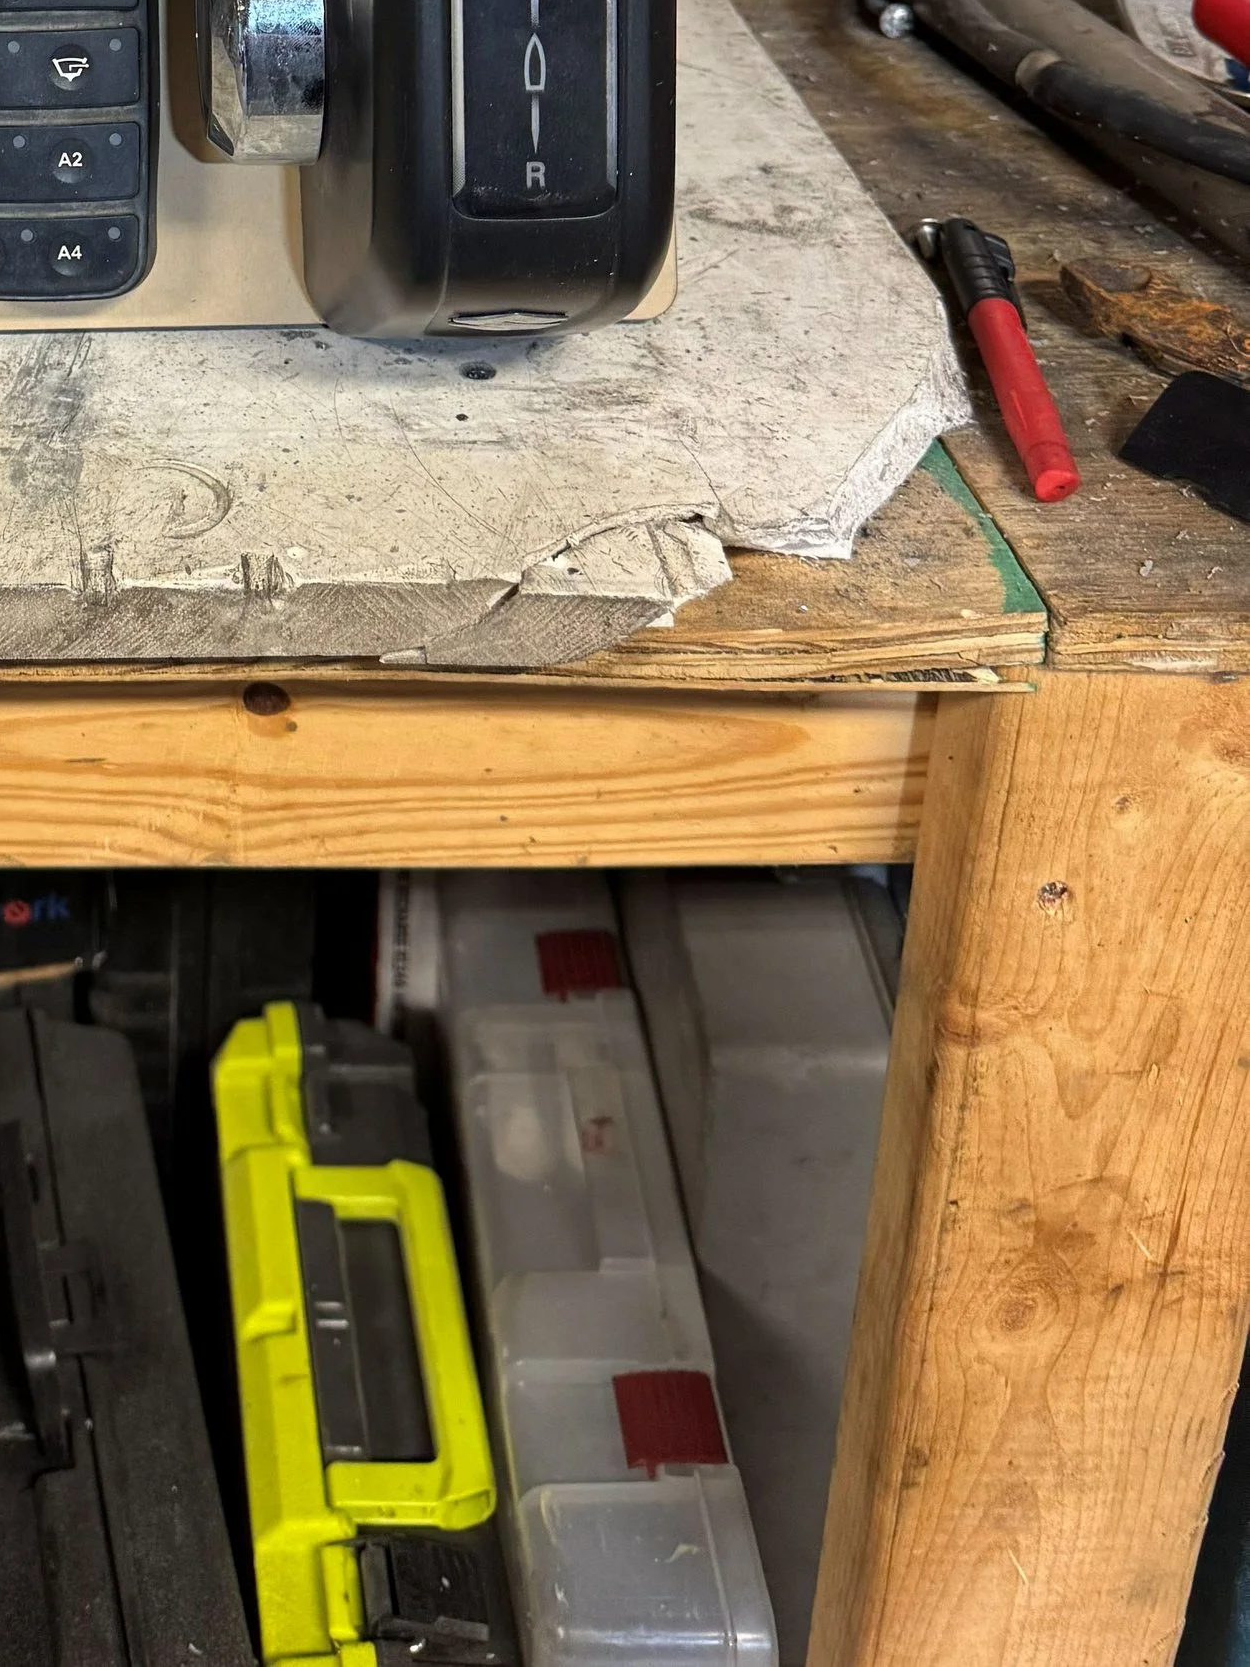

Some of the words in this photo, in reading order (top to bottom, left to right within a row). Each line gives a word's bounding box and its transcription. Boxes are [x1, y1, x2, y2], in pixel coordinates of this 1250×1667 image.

[58, 152, 83, 167] A2
[525, 161, 546, 189] R
[57, 245, 82, 260] A4
